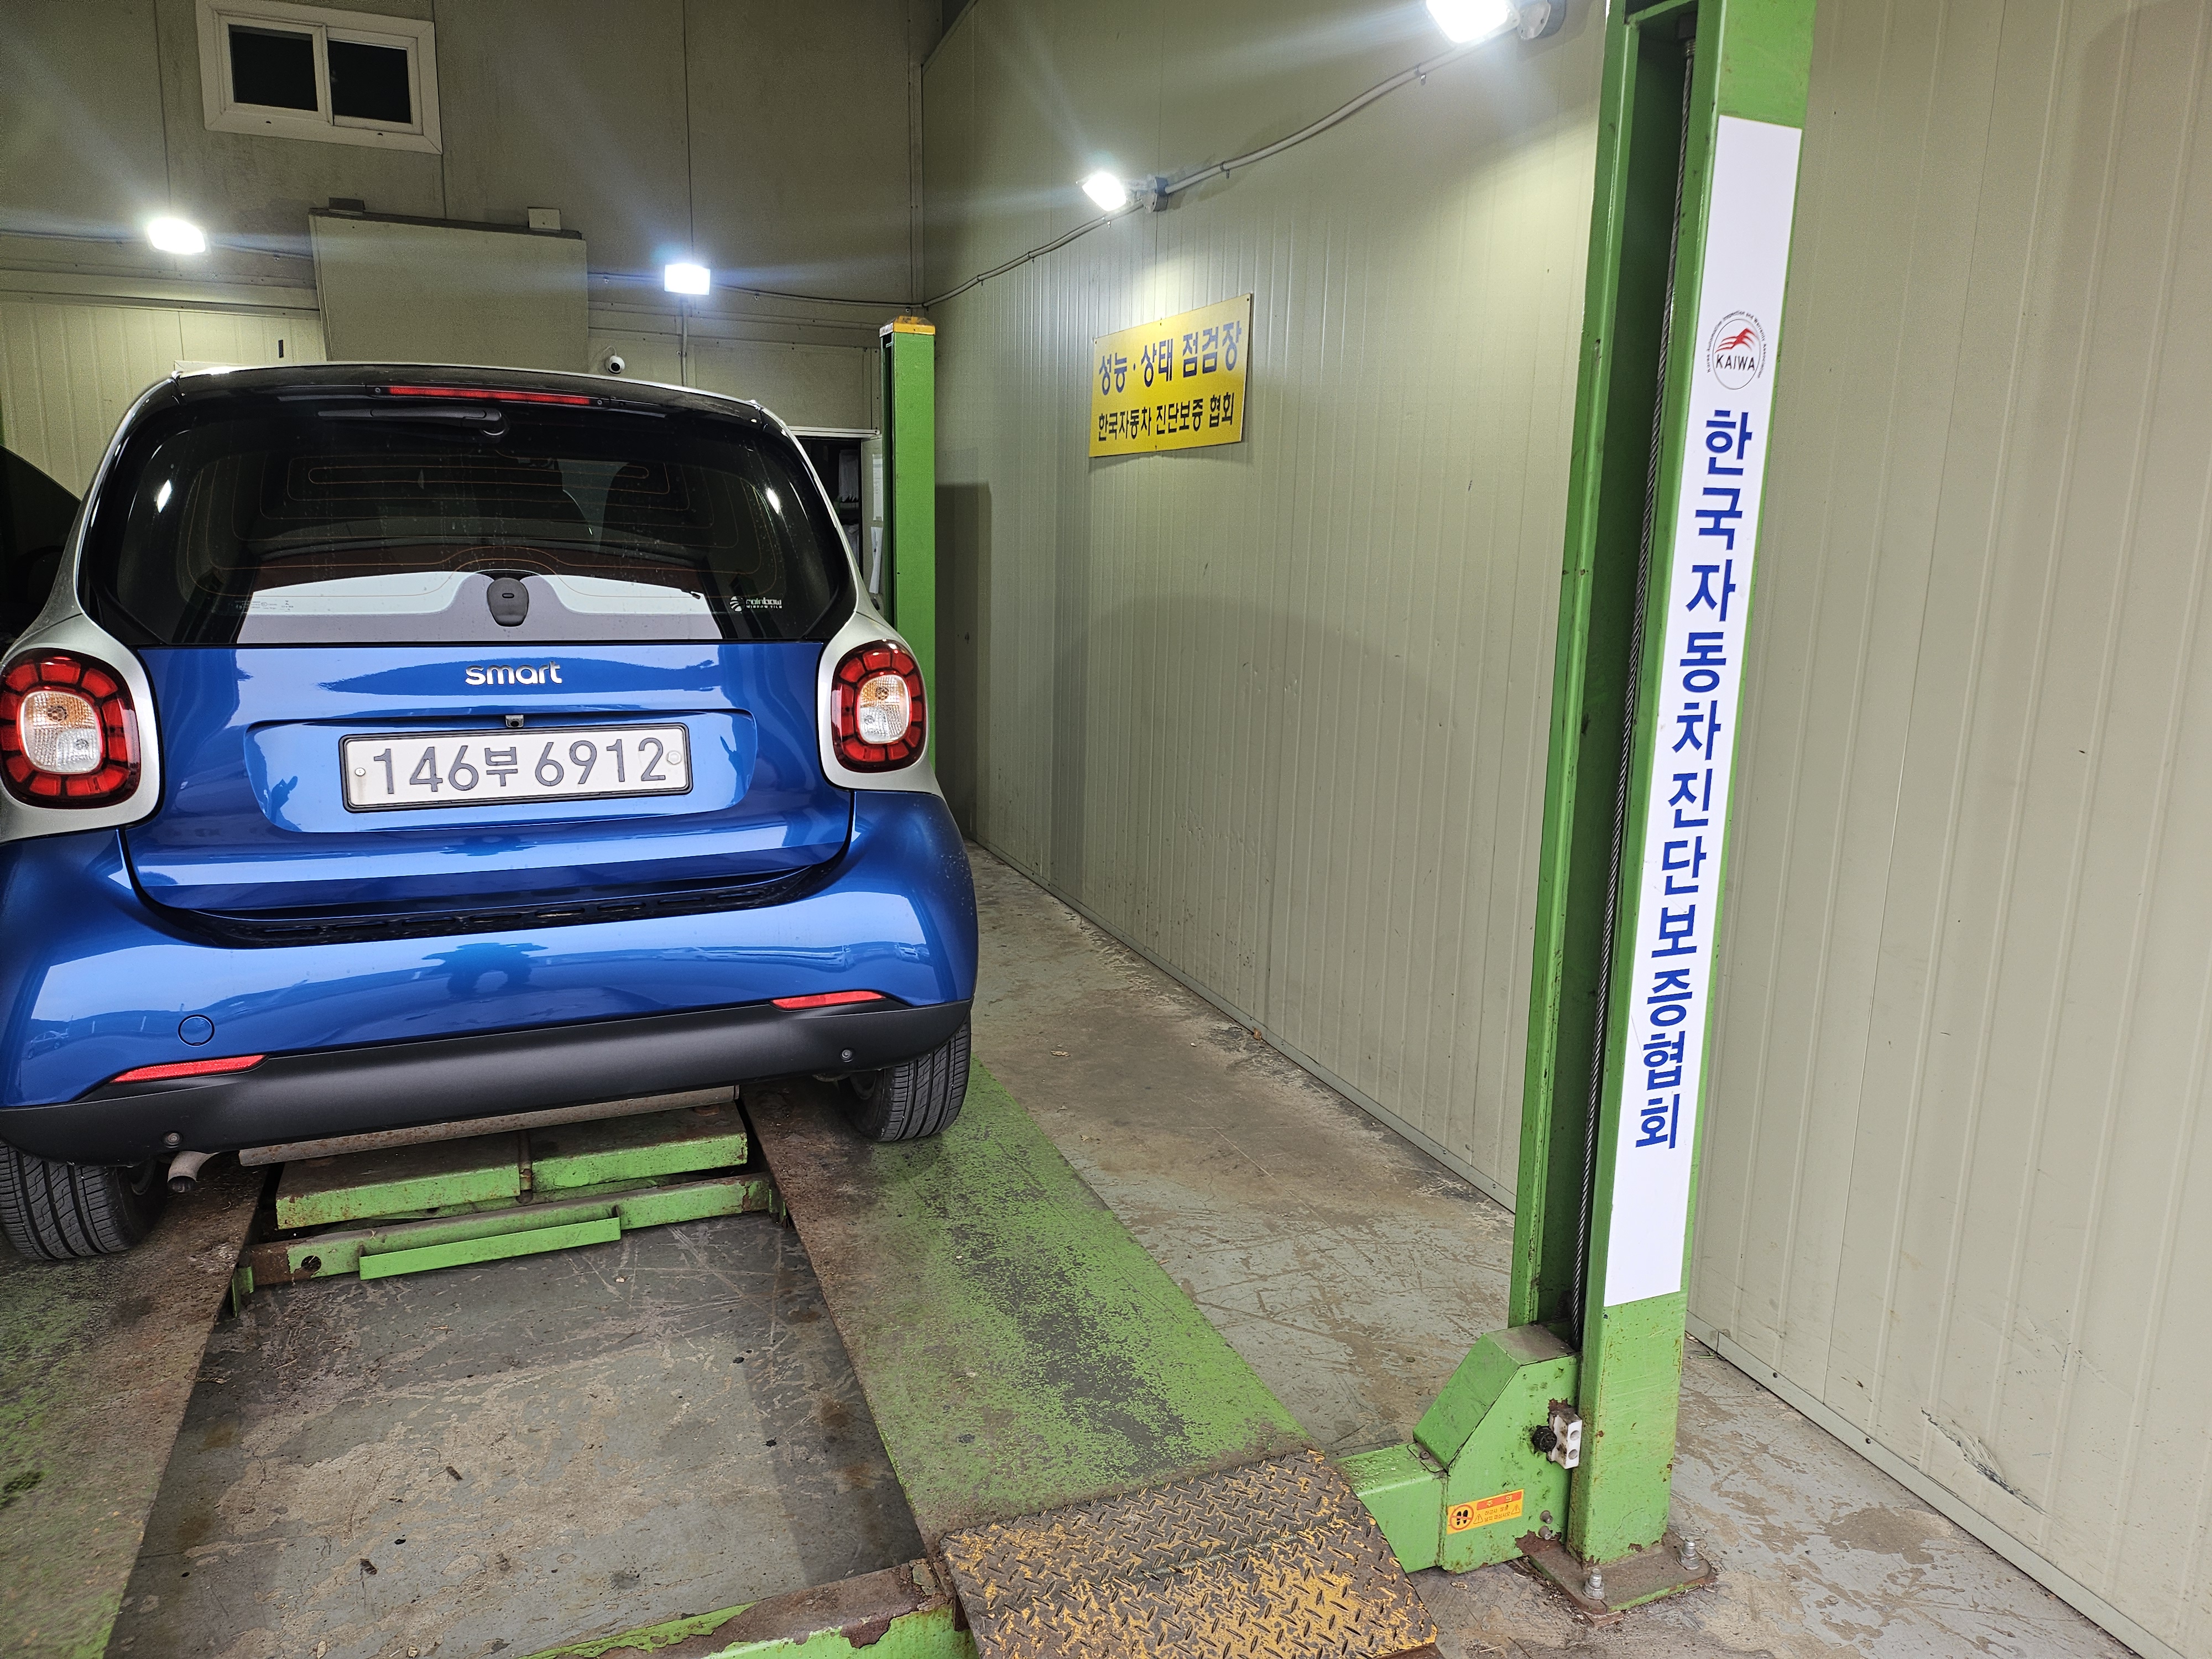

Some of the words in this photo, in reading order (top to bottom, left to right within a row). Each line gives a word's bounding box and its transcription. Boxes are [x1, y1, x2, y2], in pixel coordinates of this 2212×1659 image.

[1182, 320, 1242, 378] 점검장
[1716, 354, 1756, 372] KAIWA
[1098, 406, 1152, 442] 한국자동차
[1156, 398, 1203, 436] 진단보증
[1209, 392, 1235, 428] 협회
[465, 661, 562, 686] smart
